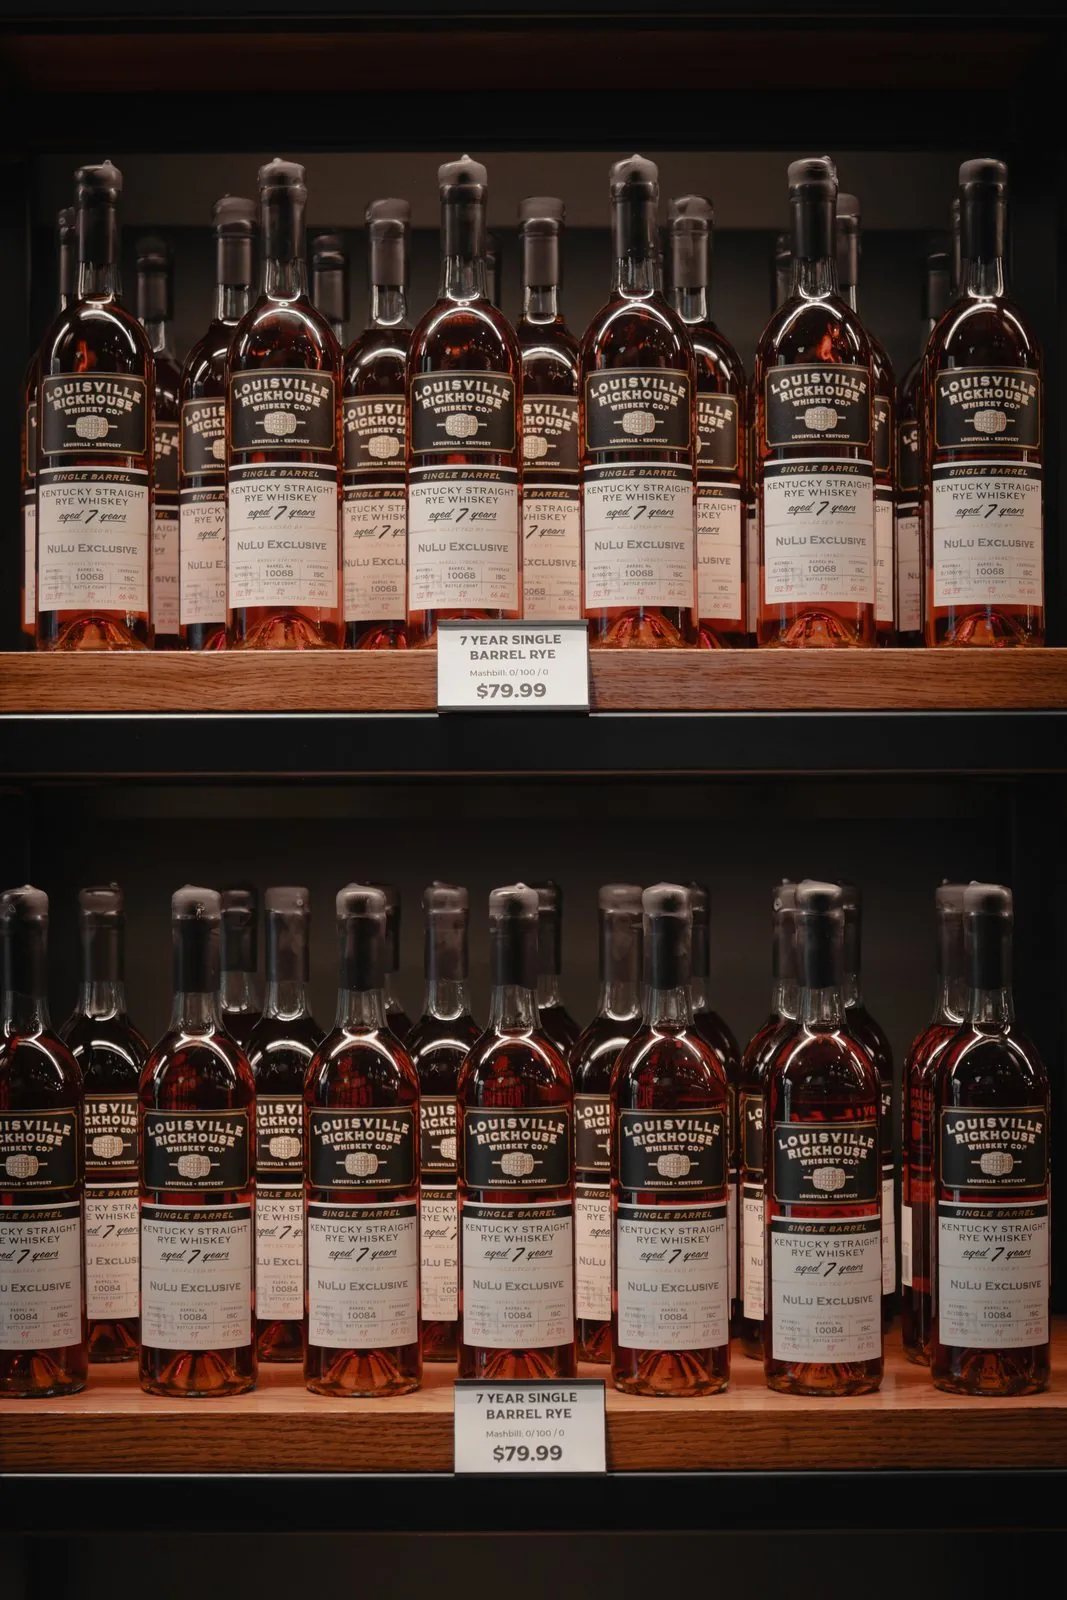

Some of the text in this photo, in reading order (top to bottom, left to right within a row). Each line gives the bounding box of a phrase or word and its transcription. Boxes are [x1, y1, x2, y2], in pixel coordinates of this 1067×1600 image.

[234, 378, 329, 399] LOUISVILLE
[590, 377, 686, 398] LOUISVILLE
[772, 372, 866, 394] LOUISVILLE
[940, 375, 1036, 397] LOUISVILLE
[46, 381, 141, 403] LOUISVILLE
[414, 379, 510, 401] LOUISVILLE
[781, 385, 862, 402] RICKHOUSE
[53, 394, 133, 411] RICKHOUSE
[241, 390, 321, 408] RICKHOUSE
[422, 392, 503, 409] RICKHOUSE
[599, 390, 680, 407] RICKHOUSE
[950, 388, 1031, 405] RICKHOUSE
[53, 473, 130, 482] SINGLE BARREL
[423, 472, 500, 480] SINGLE BARREL
[950, 468, 1028, 476] SINGLE BARREL
[231, 484, 334, 495] KENTUCKY STRAIGHT
[587, 484, 691, 494] KENTUCKY STRAIGHT
[768, 480, 872, 490] KENTUCKY STRAIGHT
[937, 482, 1041, 493] KENTUCKY STRAIGHT
[41, 488, 145, 498] KENTUCKY STRAIGHT
[411, 486, 515, 497] KENTUCKY STRAIGHT
[602, 493, 677, 502] RYE WHISKEY
[784, 489, 859, 498] RYE WHISKEY
[952, 492, 1027, 500] RYE WHISKEY
[55, 497, 129, 506] RYE WHISKEY
[244, 494, 318, 502] RYE WHISKEY
[425, 496, 499, 504] RYE WHISKEY
[787, 500, 856, 516] aged 7 years
[350, 514, 368, 522] RYE
[428, 508, 497, 522] aged 7 years
[378, 525, 391, 539] 7
[526, 524, 565, 539] 7 years
[808, 565, 837, 573] 10068
[370, 585, 398, 593] 10068
[460, 634, 561, 646] 7 YEAR SINGLE
[470, 649, 556, 660] BARREL RYE
[469, 669, 508, 677] Mashbill:
[476, 682, 546, 699] $79.99
[147, 1120, 244, 1138] LOUISVILLE
[312, 1118, 409, 1136] LOUISVILLE
[468, 1118, 565, 1136] LOUISVILLE
[624, 1119, 721, 1137] LOUISVILLE
[946, 1117, 1043, 1135] LOUISVILLE
[154, 1133, 235, 1147] RICKHOUSE
[321, 1131, 402, 1145] RICKHOUSE
[477, 1131, 558, 1145] RICKHOUSE
[633, 1132, 714, 1147] RICKHOUSE
[779, 1132, 875, 1150] LOUISVILLE
[956, 1130, 1037, 1145] RICKHOUSE
[788, 1146, 869, 1160] RICKHOUSE
[193, 1211, 234, 1220] BARREL
[674, 1210, 712, 1219] BARREL
[26, 1224, 76, 1235] STRAIGHT
[103, 1225, 115, 1239] 7
[143, 1224, 247, 1235] KENTUCKY STRAIGHT
[279, 1226, 291, 1239] 7
[310, 1222, 414, 1234] KENTUCKY STRAIGHT
[466, 1222, 570, 1234] KENTUCKY STRAIGHT
[620, 1224, 725, 1235] KENTUCKY STRAIGHT
[942, 1222, 1047, 1233] KENTUCKY STRAIGHT
[10, 1236, 60, 1244] WHISKEY
[157, 1236, 231, 1244] RYE WHISKEY
[325, 1233, 399, 1243] RYE WHISKEY
[480, 1234, 555, 1243] RYE WHISKEY
[636, 1235, 711, 1244] RYE WHISKEY
[775, 1237, 879, 1248] KENTUCKY STRAIGHT
[958, 1233, 1034, 1242] RYE WHISKEY
[16, 1249, 59, 1265] 7 years
[160, 1249, 229, 1264] aged 7 years
[484, 1247, 553, 1263] aged 7 years
[791, 1248, 865, 1257] RYE WHISKEY
[962, 1247, 1031, 1262] aged 7 years
[271, 1285, 299, 1293] 10084
[659, 1313, 688, 1321] 10084
[983, 1311, 1012, 1319] 10084
[476, 1392, 578, 1404] 7 YEAR SINGLE
[486, 1408, 572, 1420] BARREL RYE
[486, 1430, 524, 1438] Mashbill:
[493, 1445, 563, 1463] $79.99
